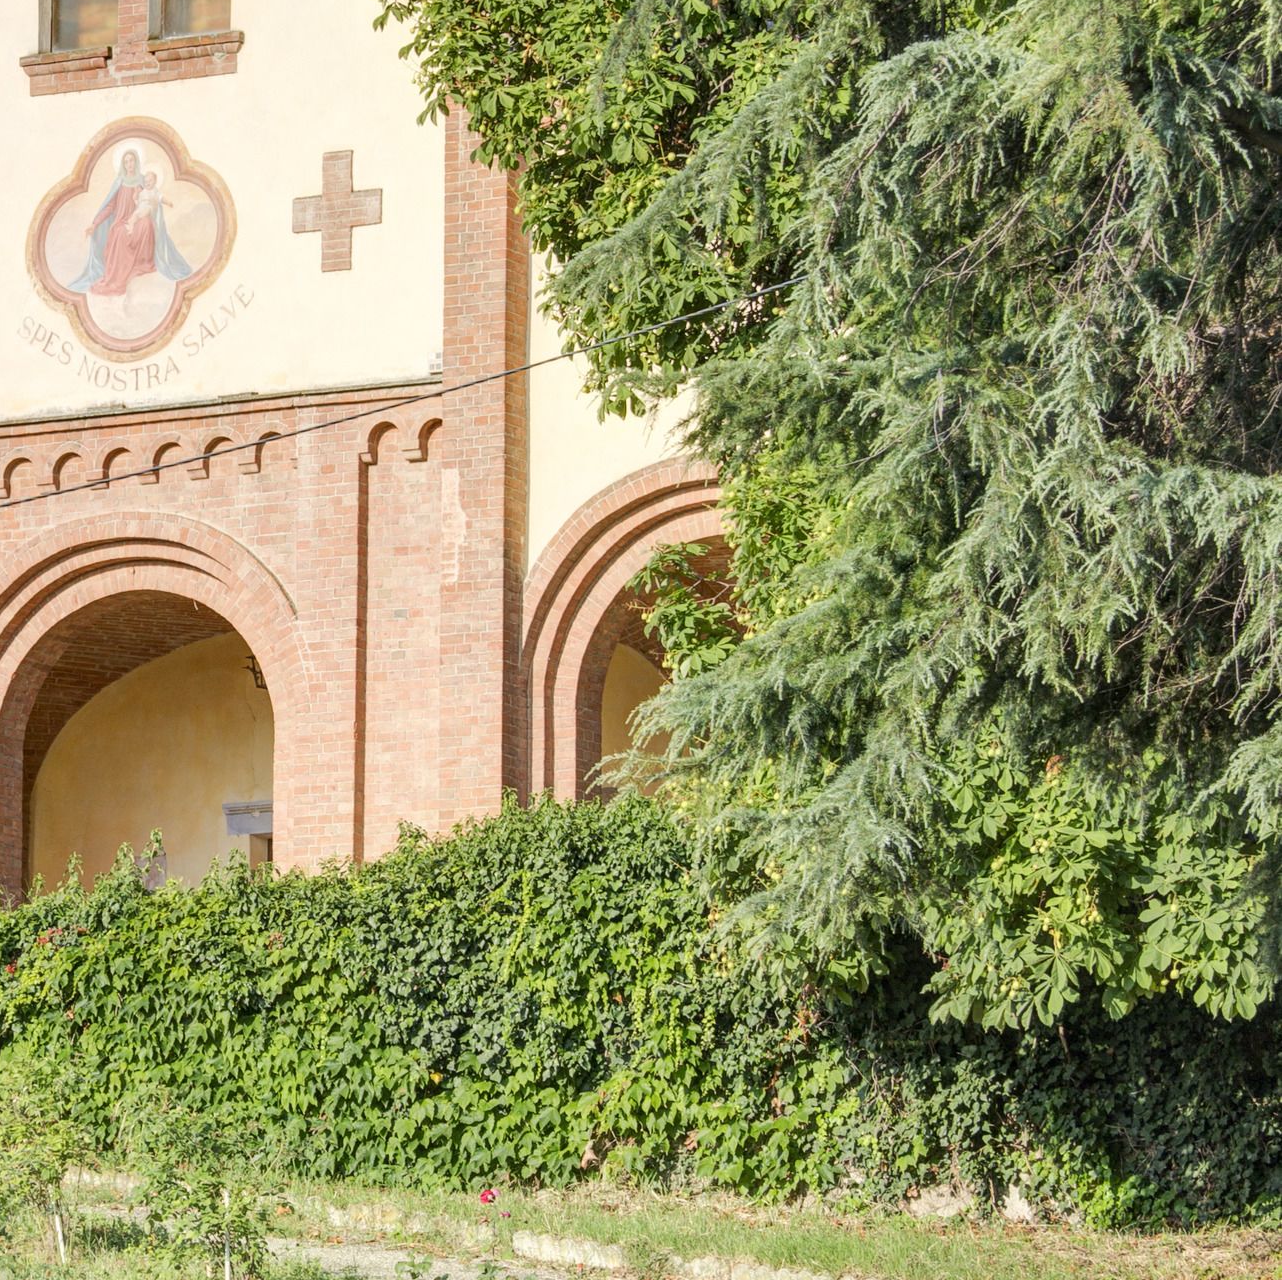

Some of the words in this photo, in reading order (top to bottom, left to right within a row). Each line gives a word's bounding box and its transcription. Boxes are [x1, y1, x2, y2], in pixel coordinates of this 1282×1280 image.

[17, 316, 74, 365] SPES
[77, 356, 180, 391] NOSTRA
[182, 285, 255, 357] SALVE
